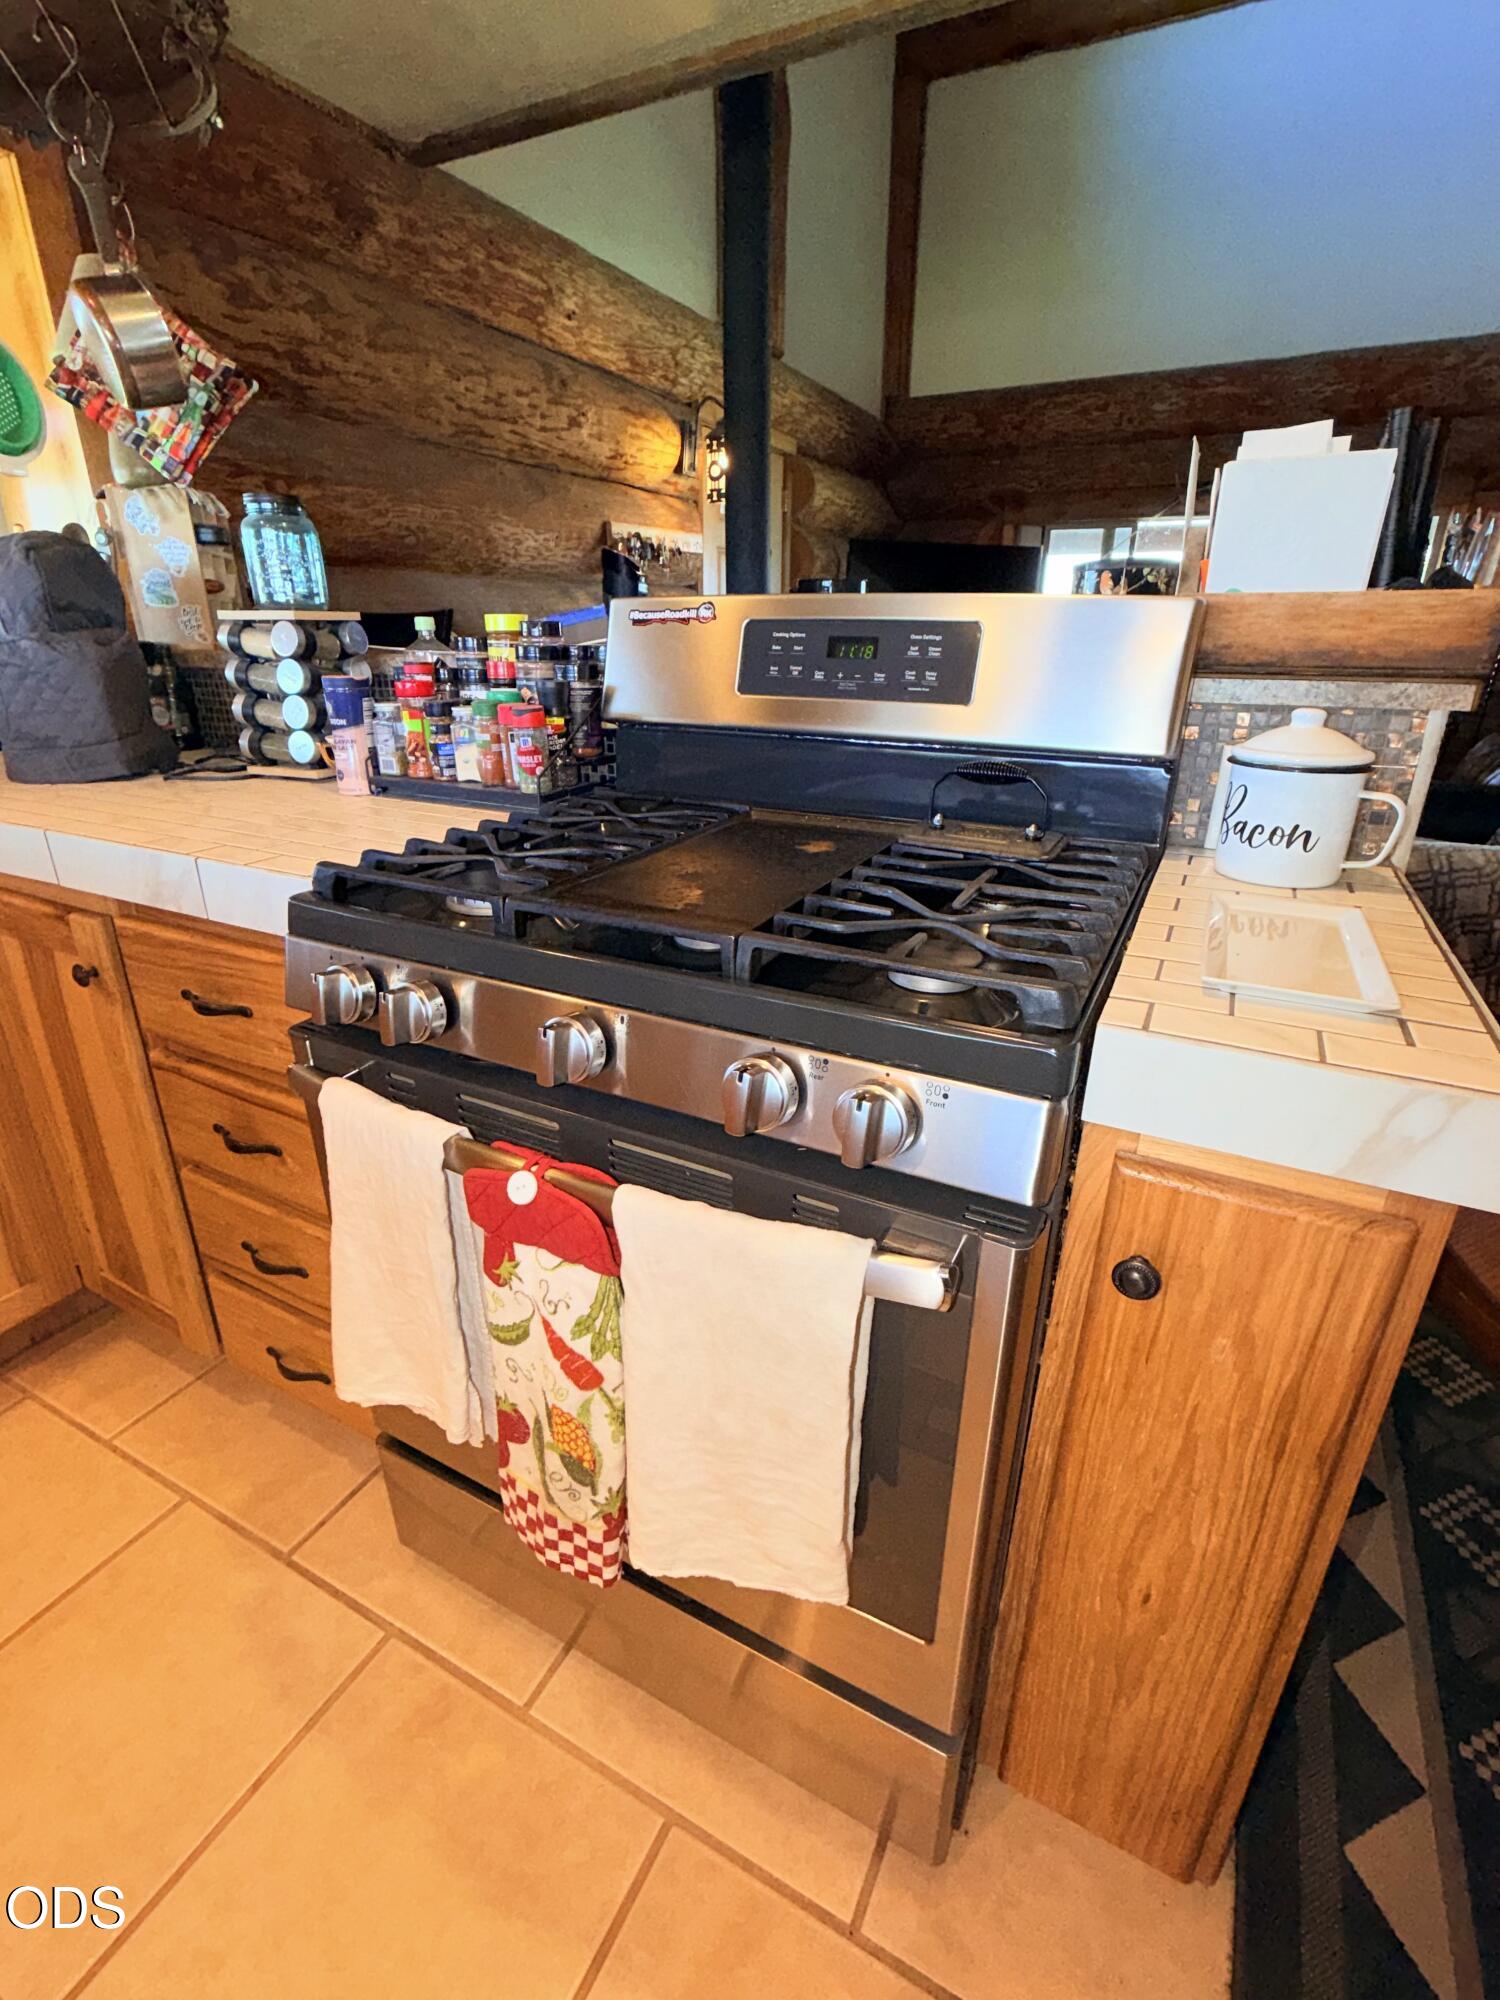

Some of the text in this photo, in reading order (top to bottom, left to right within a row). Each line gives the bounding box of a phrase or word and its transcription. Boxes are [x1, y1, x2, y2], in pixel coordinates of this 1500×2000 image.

[1220, 781, 1321, 853] Bacon
[809, 1072, 825, 1081] Rear
[925, 1098, 946, 1109] Front
